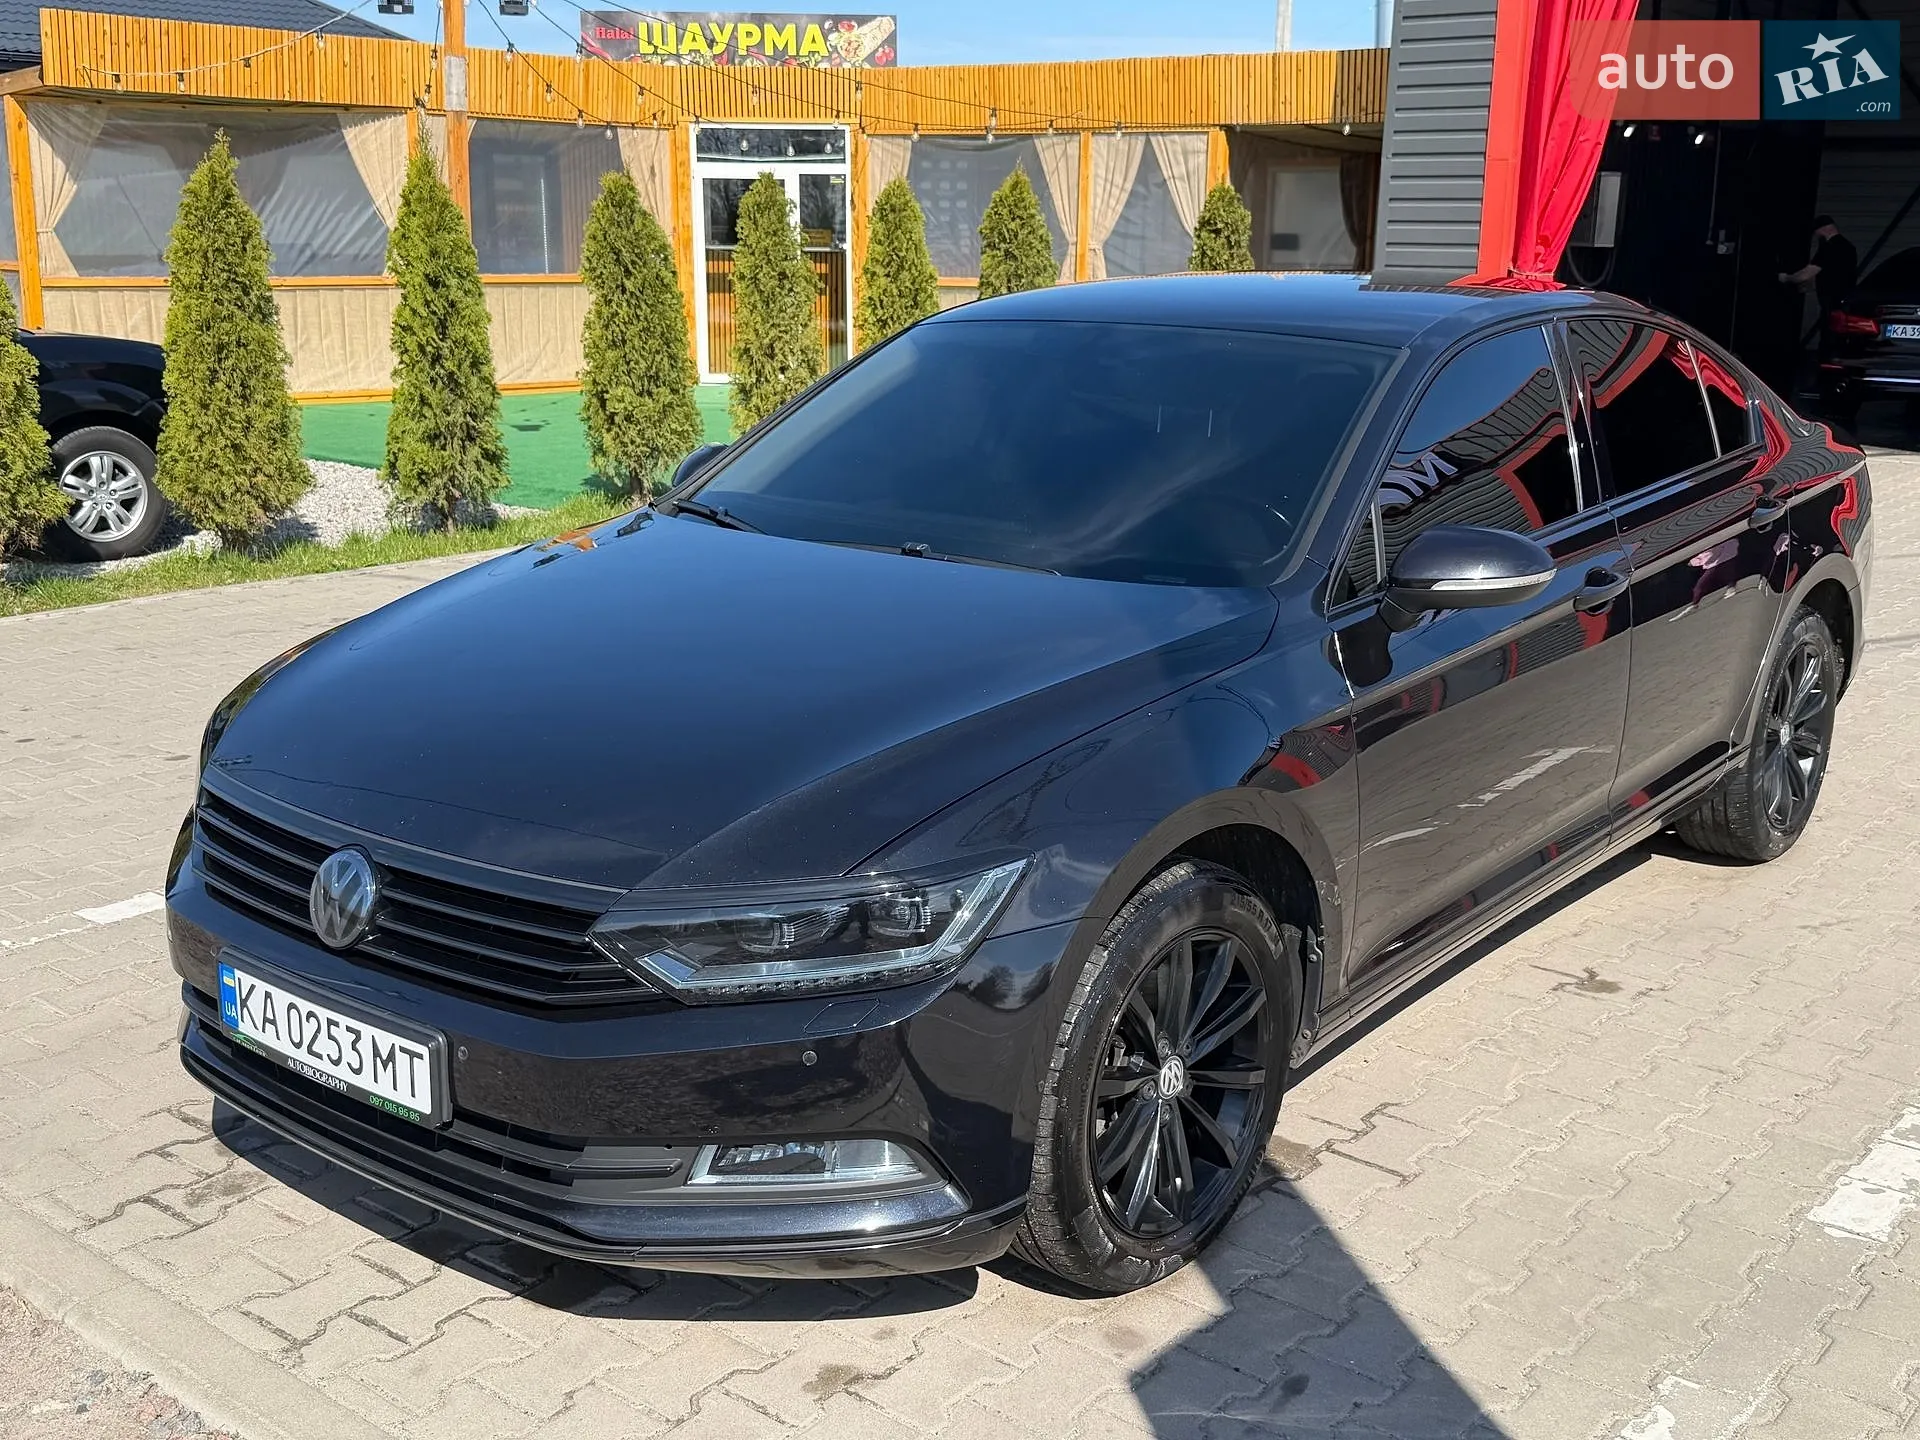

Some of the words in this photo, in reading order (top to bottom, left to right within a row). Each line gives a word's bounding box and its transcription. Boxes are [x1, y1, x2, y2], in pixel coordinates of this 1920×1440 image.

[595, 25, 635, 40] Halal
[638, 21, 830, 57] ШАУРМА
[1892, 326, 1907, 337] KA
[225, 1000, 238, 1020] UA
[237, 976, 281, 1041] KA
[286, 1001, 364, 1076] 0253
[371, 1034, 424, 1099] MT
[287, 1057, 349, 1093] AUTOBIOGRAPHY
[369, 1095, 383, 1107] 097
[384, 1101, 397, 1113] 015
